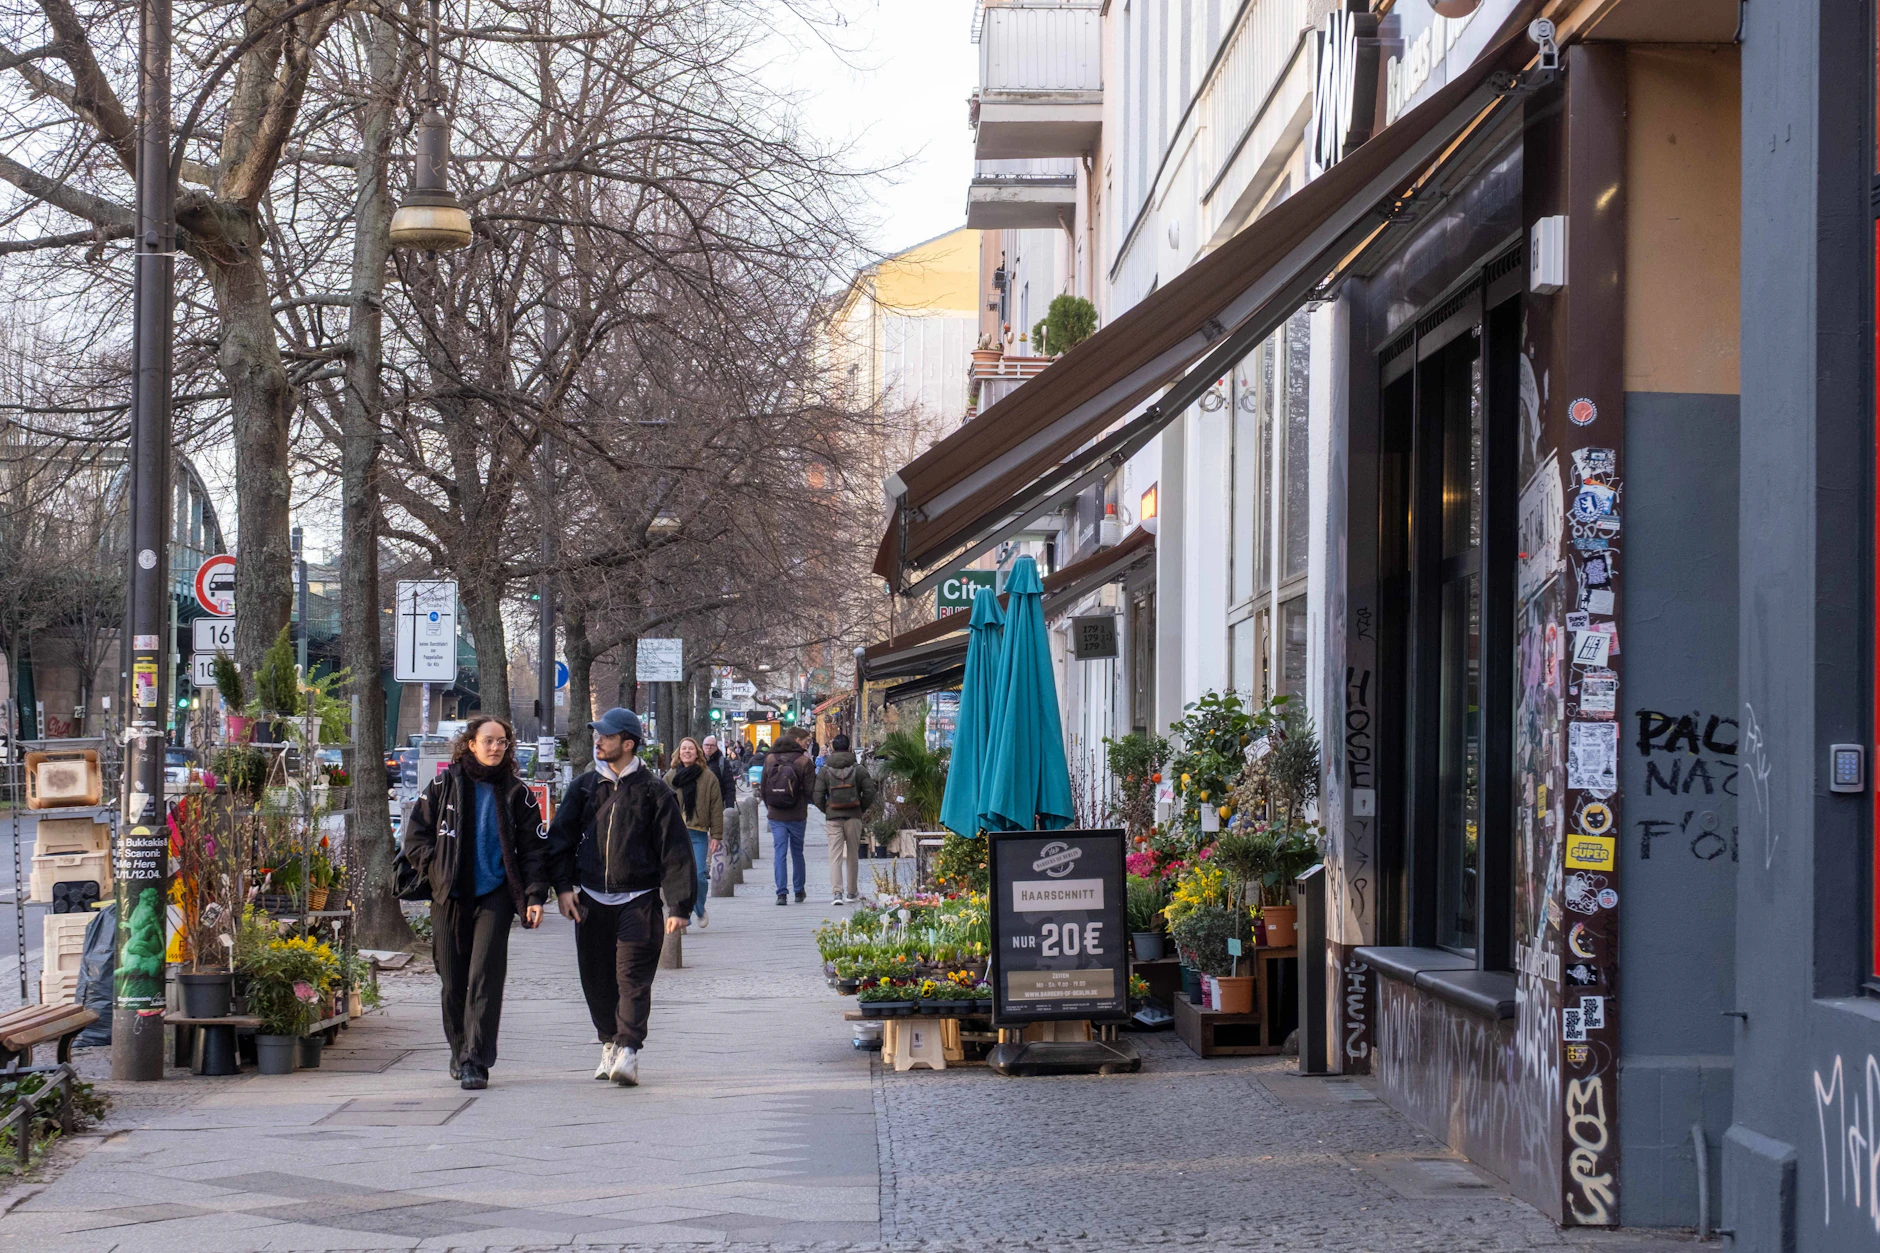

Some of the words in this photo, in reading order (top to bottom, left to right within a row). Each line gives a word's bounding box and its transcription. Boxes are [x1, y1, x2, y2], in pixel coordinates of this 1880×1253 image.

[943, 576, 991, 600] Cit
[1082, 625, 1099, 634] 179
[1083, 634, 1099, 642] 179
[1084, 643, 1100, 651] 179
[1571, 848, 1608, 860] SUPER
[133, 860, 156, 868] Here
[1021, 889, 1095, 901] HAARSCHNITT
[1012, 936, 1036, 948] NUR
[1042, 922, 1104, 956] 20€
[1566, 1024, 1576, 1032] TO
